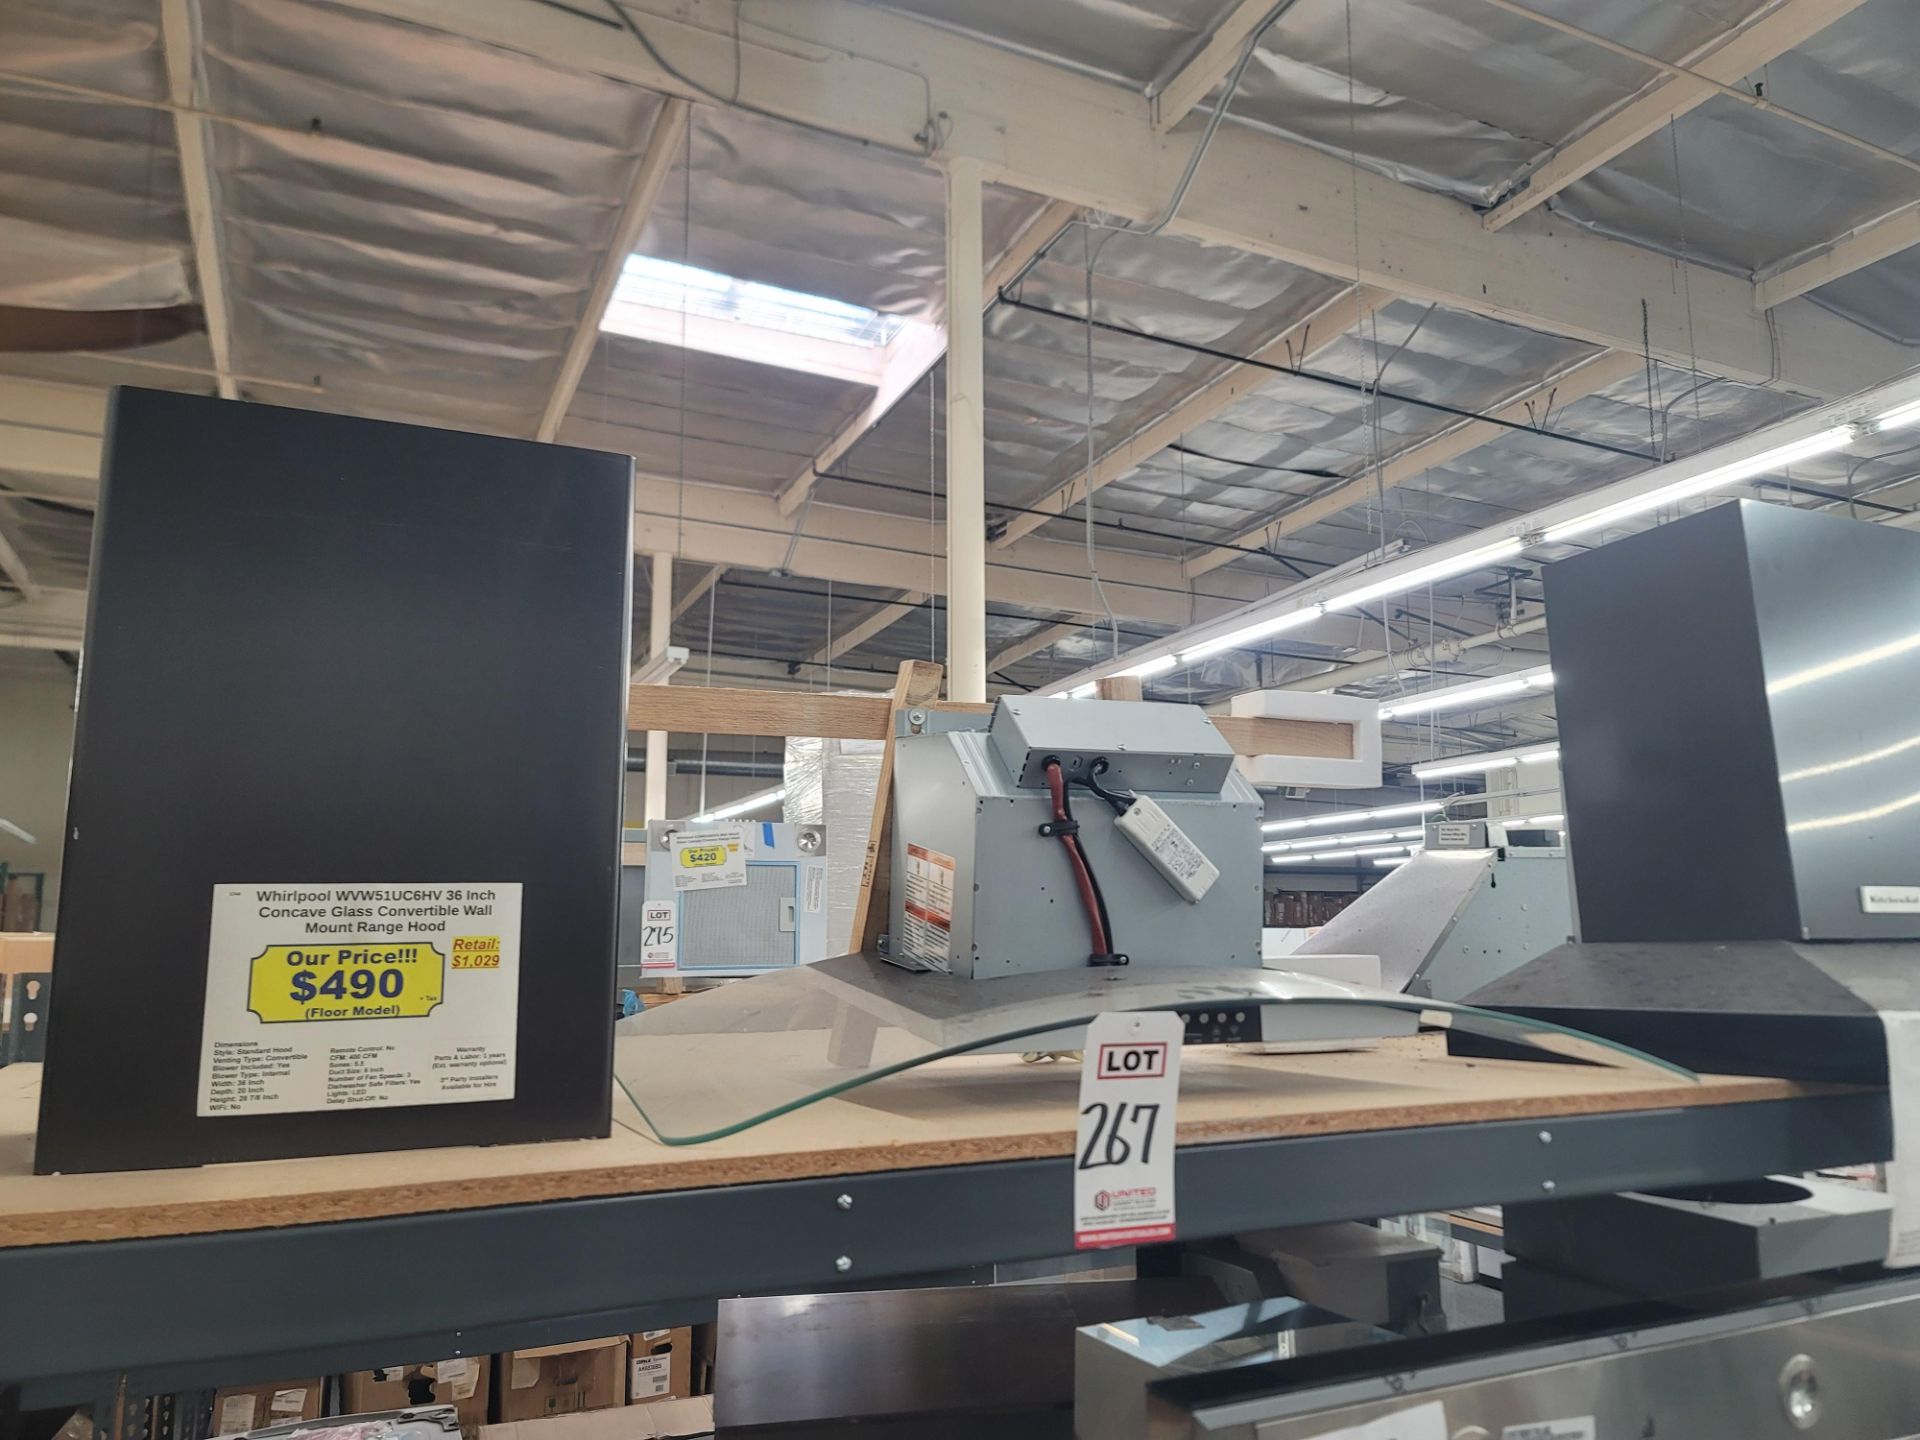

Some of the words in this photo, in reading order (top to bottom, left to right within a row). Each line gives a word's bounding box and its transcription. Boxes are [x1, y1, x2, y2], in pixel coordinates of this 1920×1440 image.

[689, 852, 717, 862] $420
[256, 890, 331, 904] Whirlpool
[335, 889, 443, 901] WVW51UC6HV
[446, 889, 462, 901] 36
[466, 889, 496, 900] Inch
[259, 906, 327, 918] Concave
[331, 905, 373, 918] Glass
[377, 904, 460, 917] Convertible
[463, 904, 493, 916] Wall
[650, 911, 669, 919] LOT
[305, 922, 353, 934] Mount
[357, 920, 403, 935] Range
[408, 920, 446, 932] Hood
[642, 925, 675, 947] 275
[453, 937, 501, 951] Retail:
[287, 951, 330, 967] Our
[338, 948, 418, 965] Price!!!
[452, 953, 501, 968] $1,029
[289, 968, 405, 1006] $490
[305, 1006, 348, 1020] (Floor
[352, 1004, 401, 1018] Model)
[214, 1041, 259, 1049] Dimensions
[237, 1047, 272, 1055] Standard
[213, 1057, 241, 1065] Venting
[265, 1053, 308, 1061] Convertible
[362, 1052, 379, 1060] CFM
[1106, 1050, 1160, 1072] LOT
[1077, 1102, 1161, 1171] 267
[1111, 1187, 1157, 1198] UNITED
